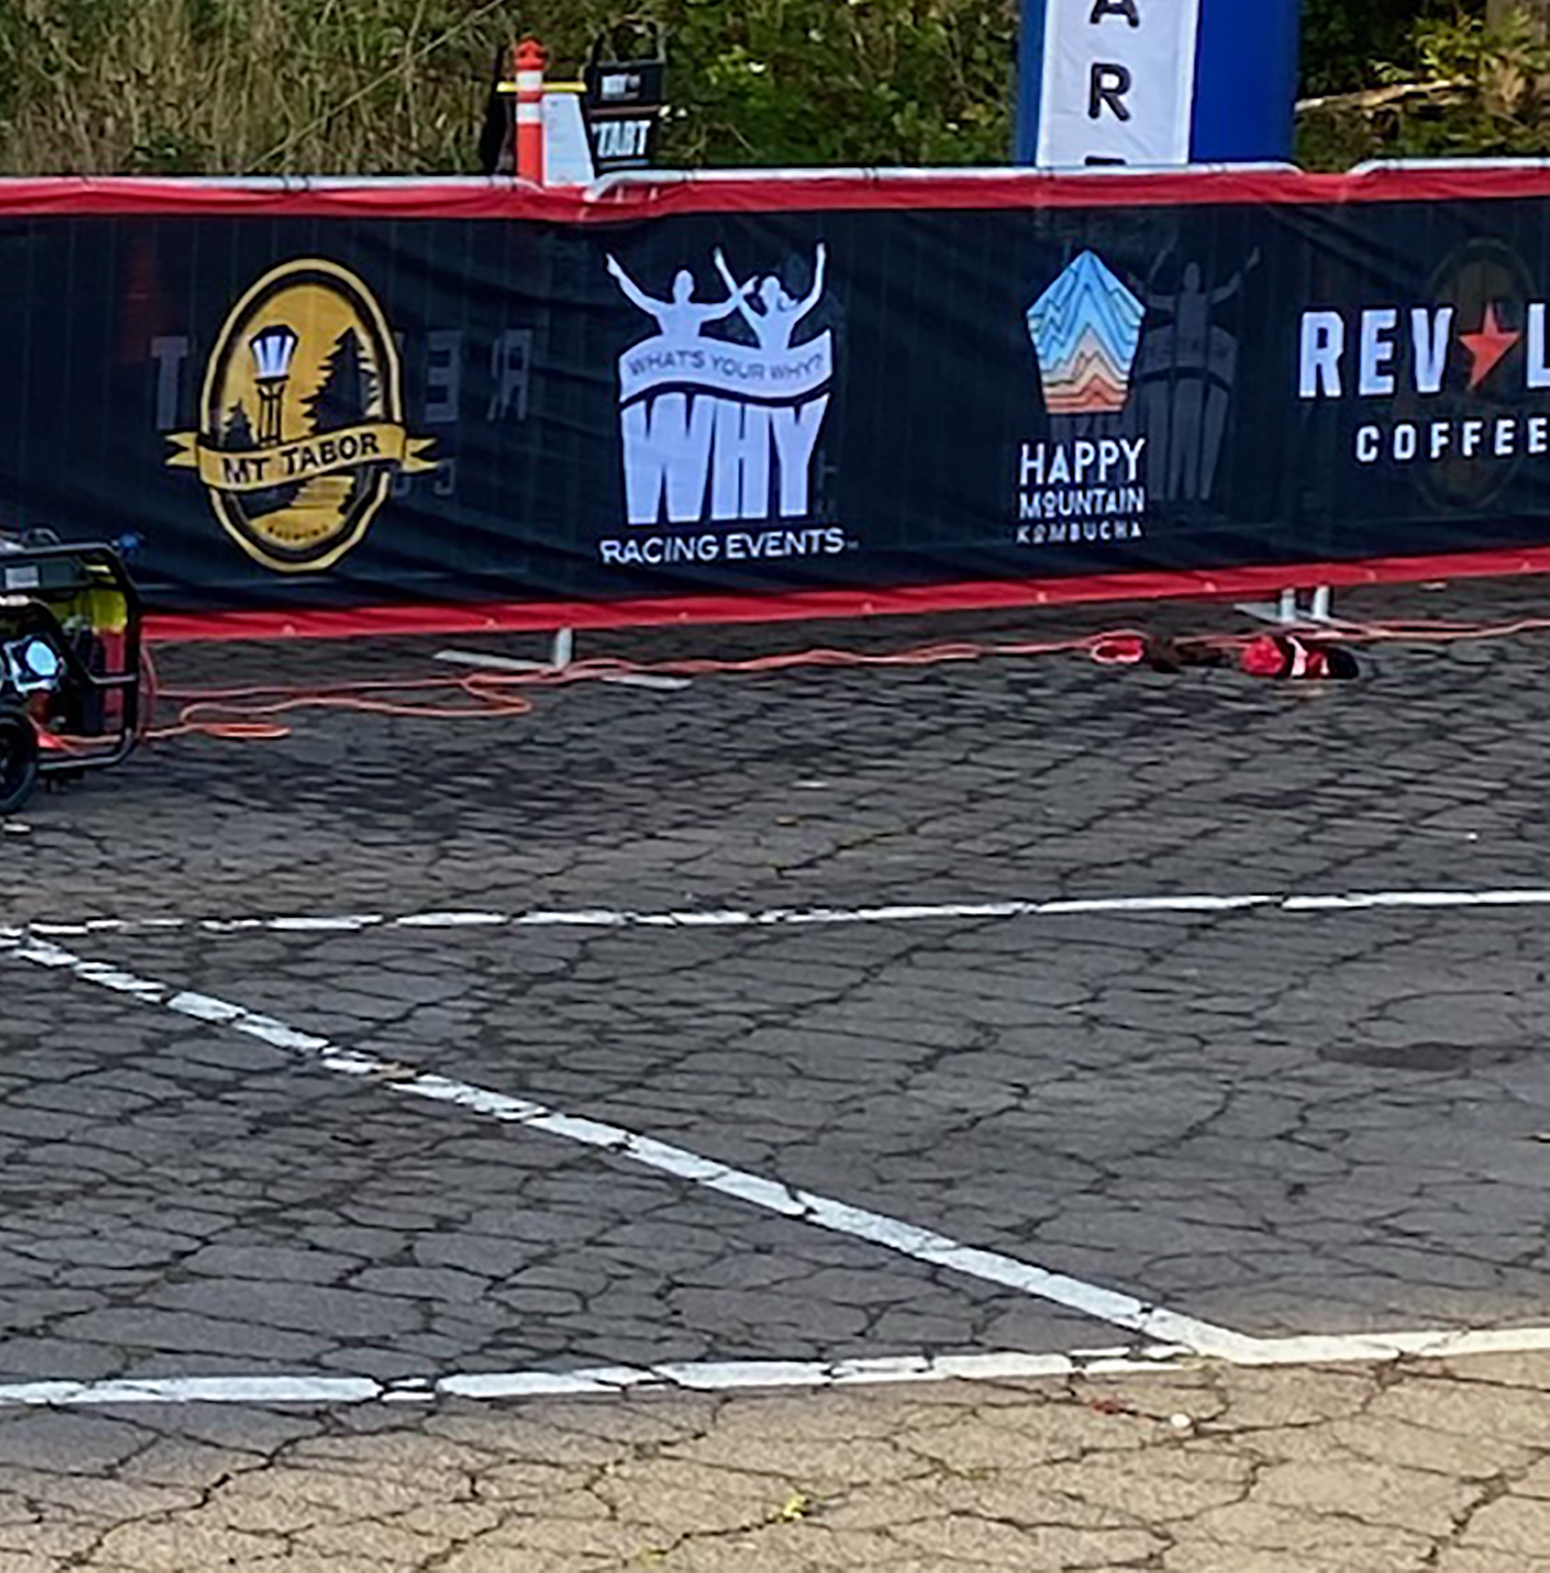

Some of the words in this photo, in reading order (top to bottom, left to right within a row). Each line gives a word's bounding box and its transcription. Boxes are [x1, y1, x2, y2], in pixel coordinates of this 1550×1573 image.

[711, 356, 765, 379] YOUR
[771, 354, 824, 379] WHY?
[221, 457, 270, 484] MT
[280, 432, 380, 475] TABOR
[620, 392, 831, 525] WHY
[1356, 418, 1548, 462] COFFEE
[1019, 438, 1145, 485] HAPPY
[1019, 487, 1145, 518] MOUNTAIN
[600, 535, 719, 564] RACING
[726, 527, 845, 559] EVENTS
[1016, 520, 1142, 544] KOMBUCHA
